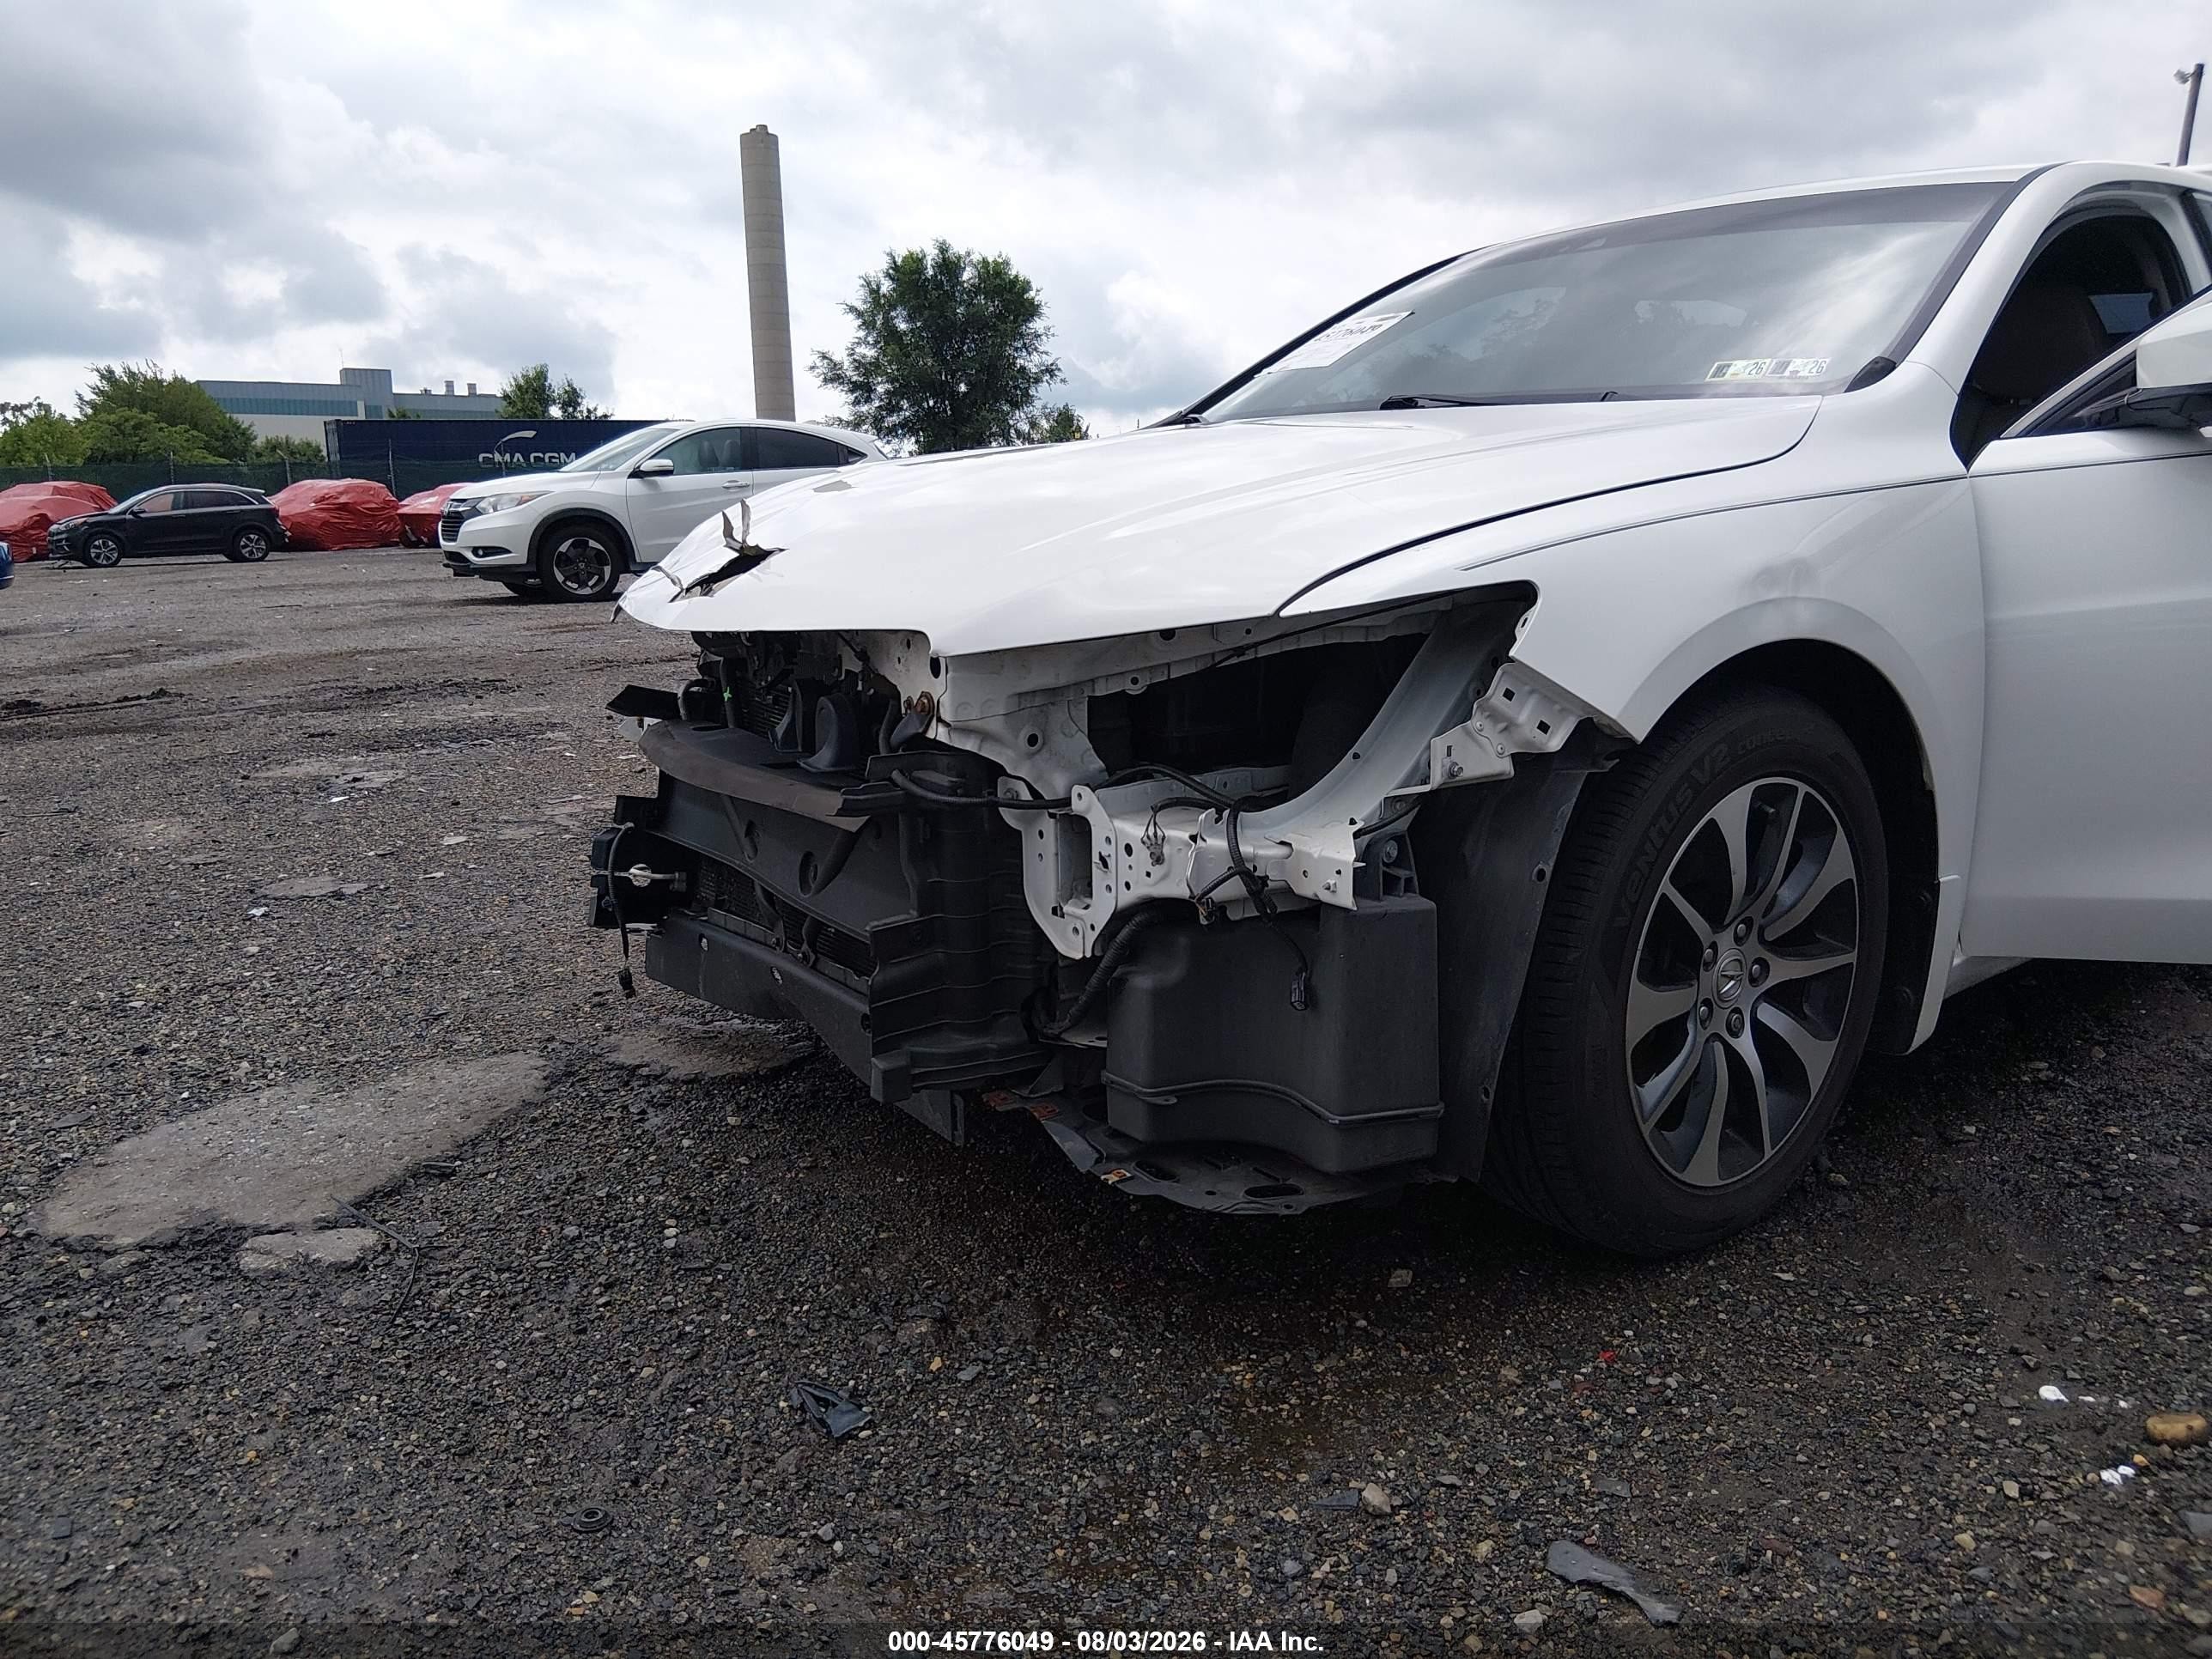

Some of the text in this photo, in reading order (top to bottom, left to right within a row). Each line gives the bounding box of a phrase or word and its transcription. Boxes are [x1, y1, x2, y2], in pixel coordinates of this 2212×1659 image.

[1747, 362, 1767, 376] 26
[1808, 360, 1827, 374] 26
[478, 453, 576, 468] CMA CGM
[1690, 743, 1731, 785] V2
